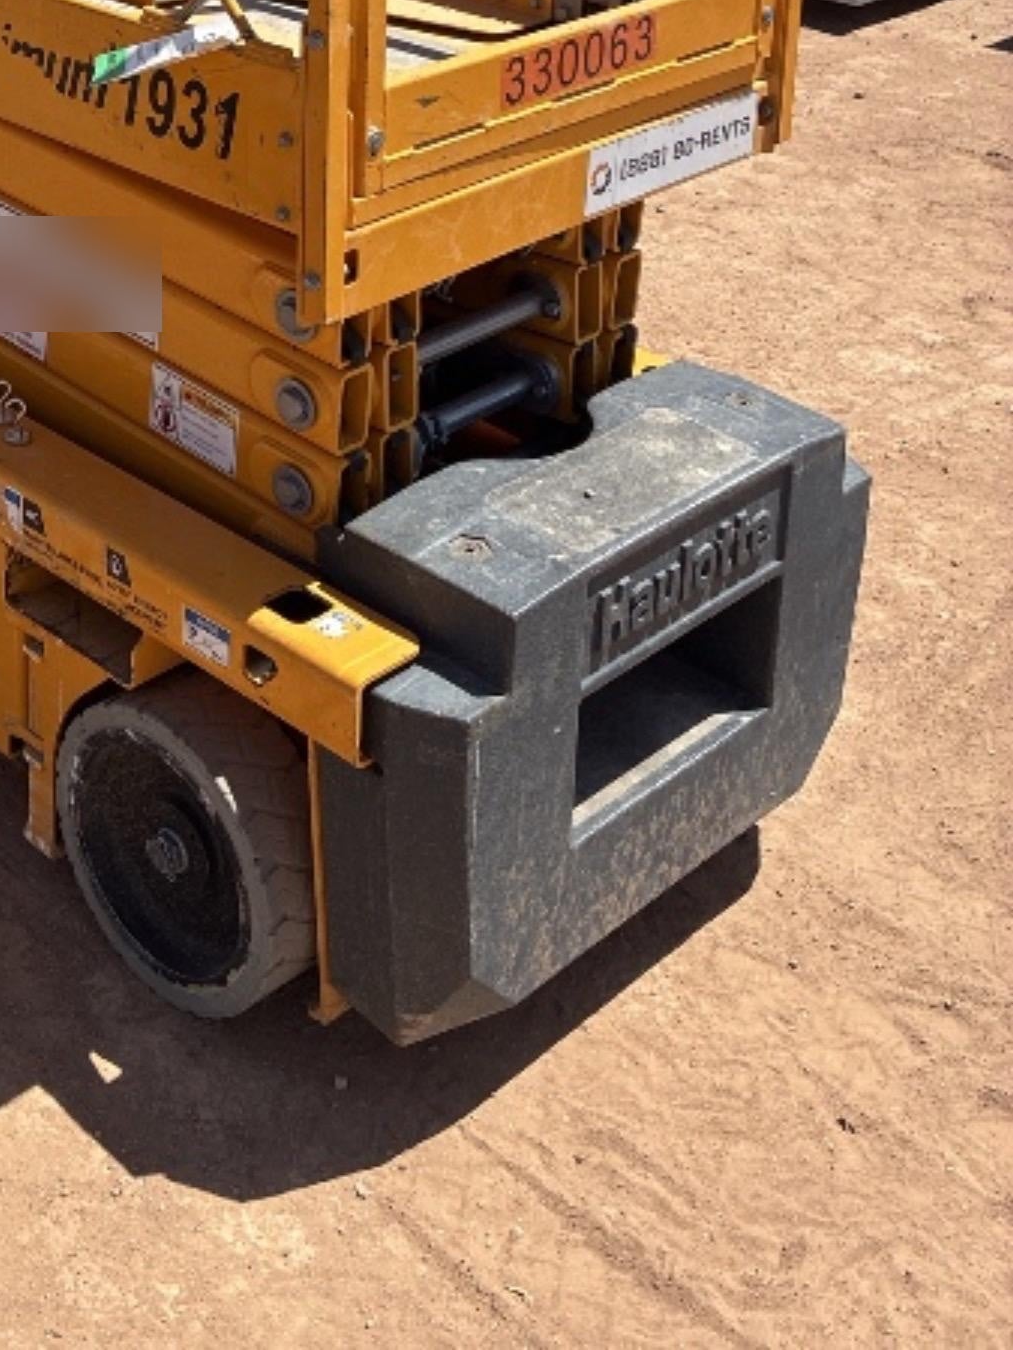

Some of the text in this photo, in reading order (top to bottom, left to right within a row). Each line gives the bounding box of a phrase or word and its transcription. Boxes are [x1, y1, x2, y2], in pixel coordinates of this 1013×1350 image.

[504, 14, 655, 106] 330063
[119, 68, 240, 160] 1931
[590, 508, 771, 662] Haulotte
